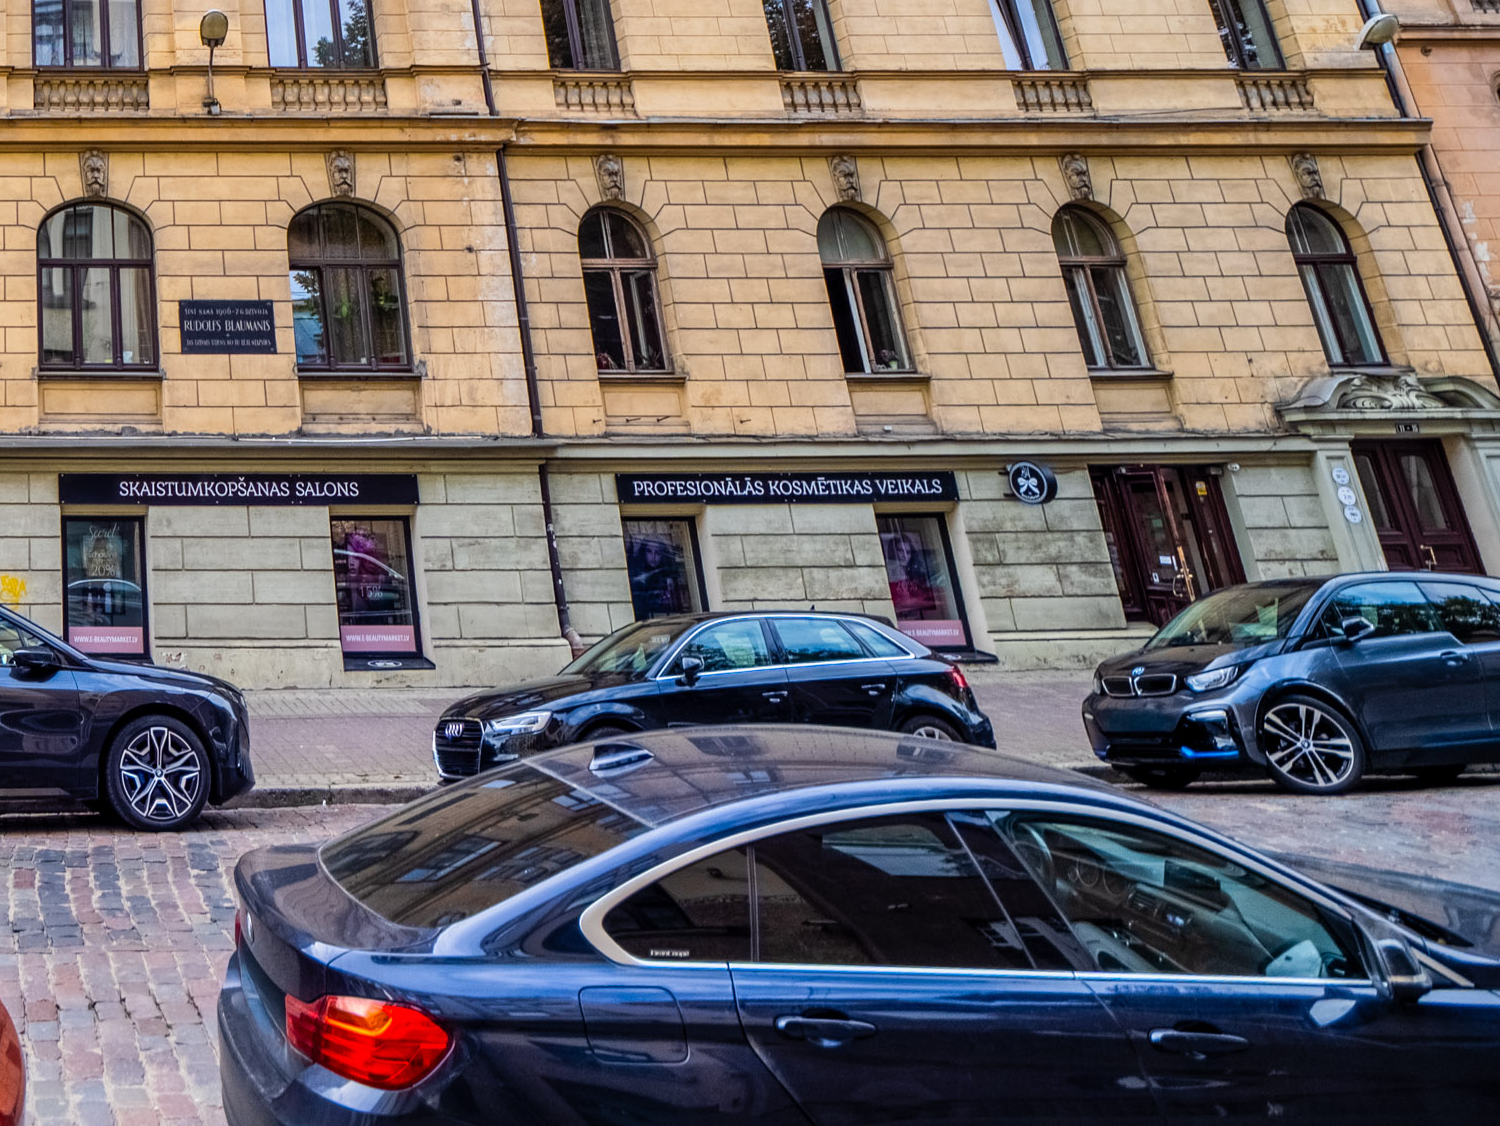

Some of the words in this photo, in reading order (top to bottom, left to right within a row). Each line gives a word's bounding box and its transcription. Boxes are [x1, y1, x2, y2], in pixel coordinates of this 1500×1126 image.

[184, 320, 221, 331] RUDOLFS
[225, 320, 271, 331] BLAUMANIS
[119, 476, 290, 497] SKAISTUMKOPŠANAS
[295, 481, 360, 497] SALONS
[632, 477, 765, 496] PROFESIONĀLĀS
[768, 477, 873, 496] KOSMĒTIKAS
[874, 479, 943, 495] VEIKALS
